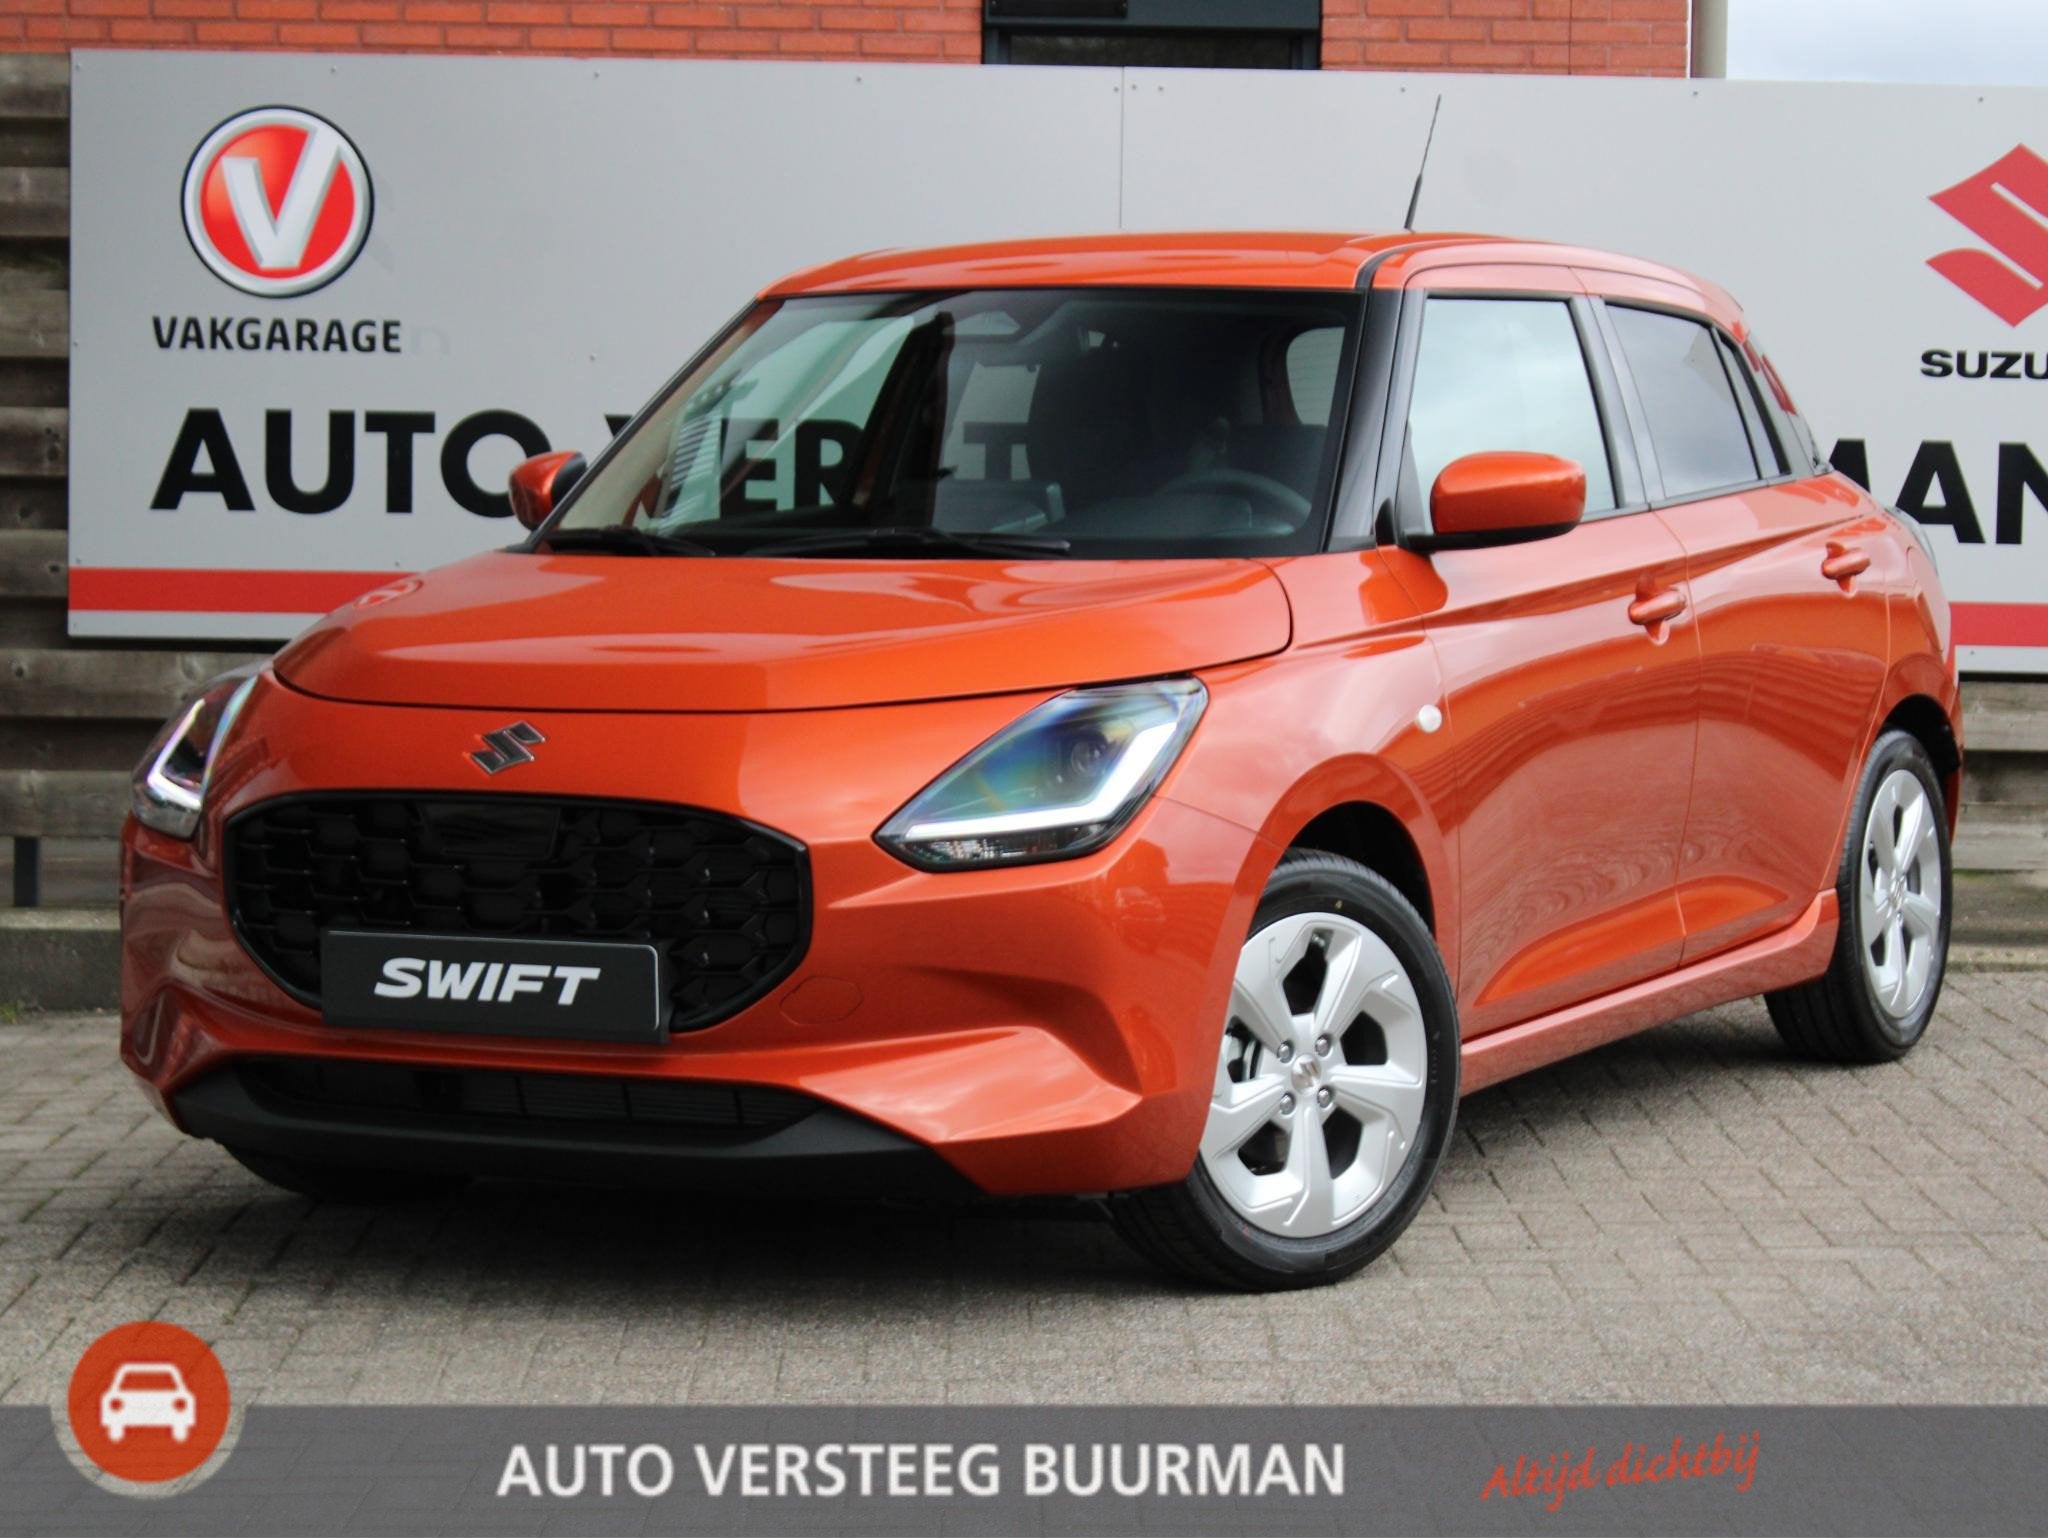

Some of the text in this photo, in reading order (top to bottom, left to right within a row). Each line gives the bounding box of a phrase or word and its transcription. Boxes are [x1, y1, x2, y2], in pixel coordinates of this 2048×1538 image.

[152, 315, 402, 353] VAKGARAGE
[150, 408, 552, 519] AUTO
[373, 957, 601, 1006] SWIFT
